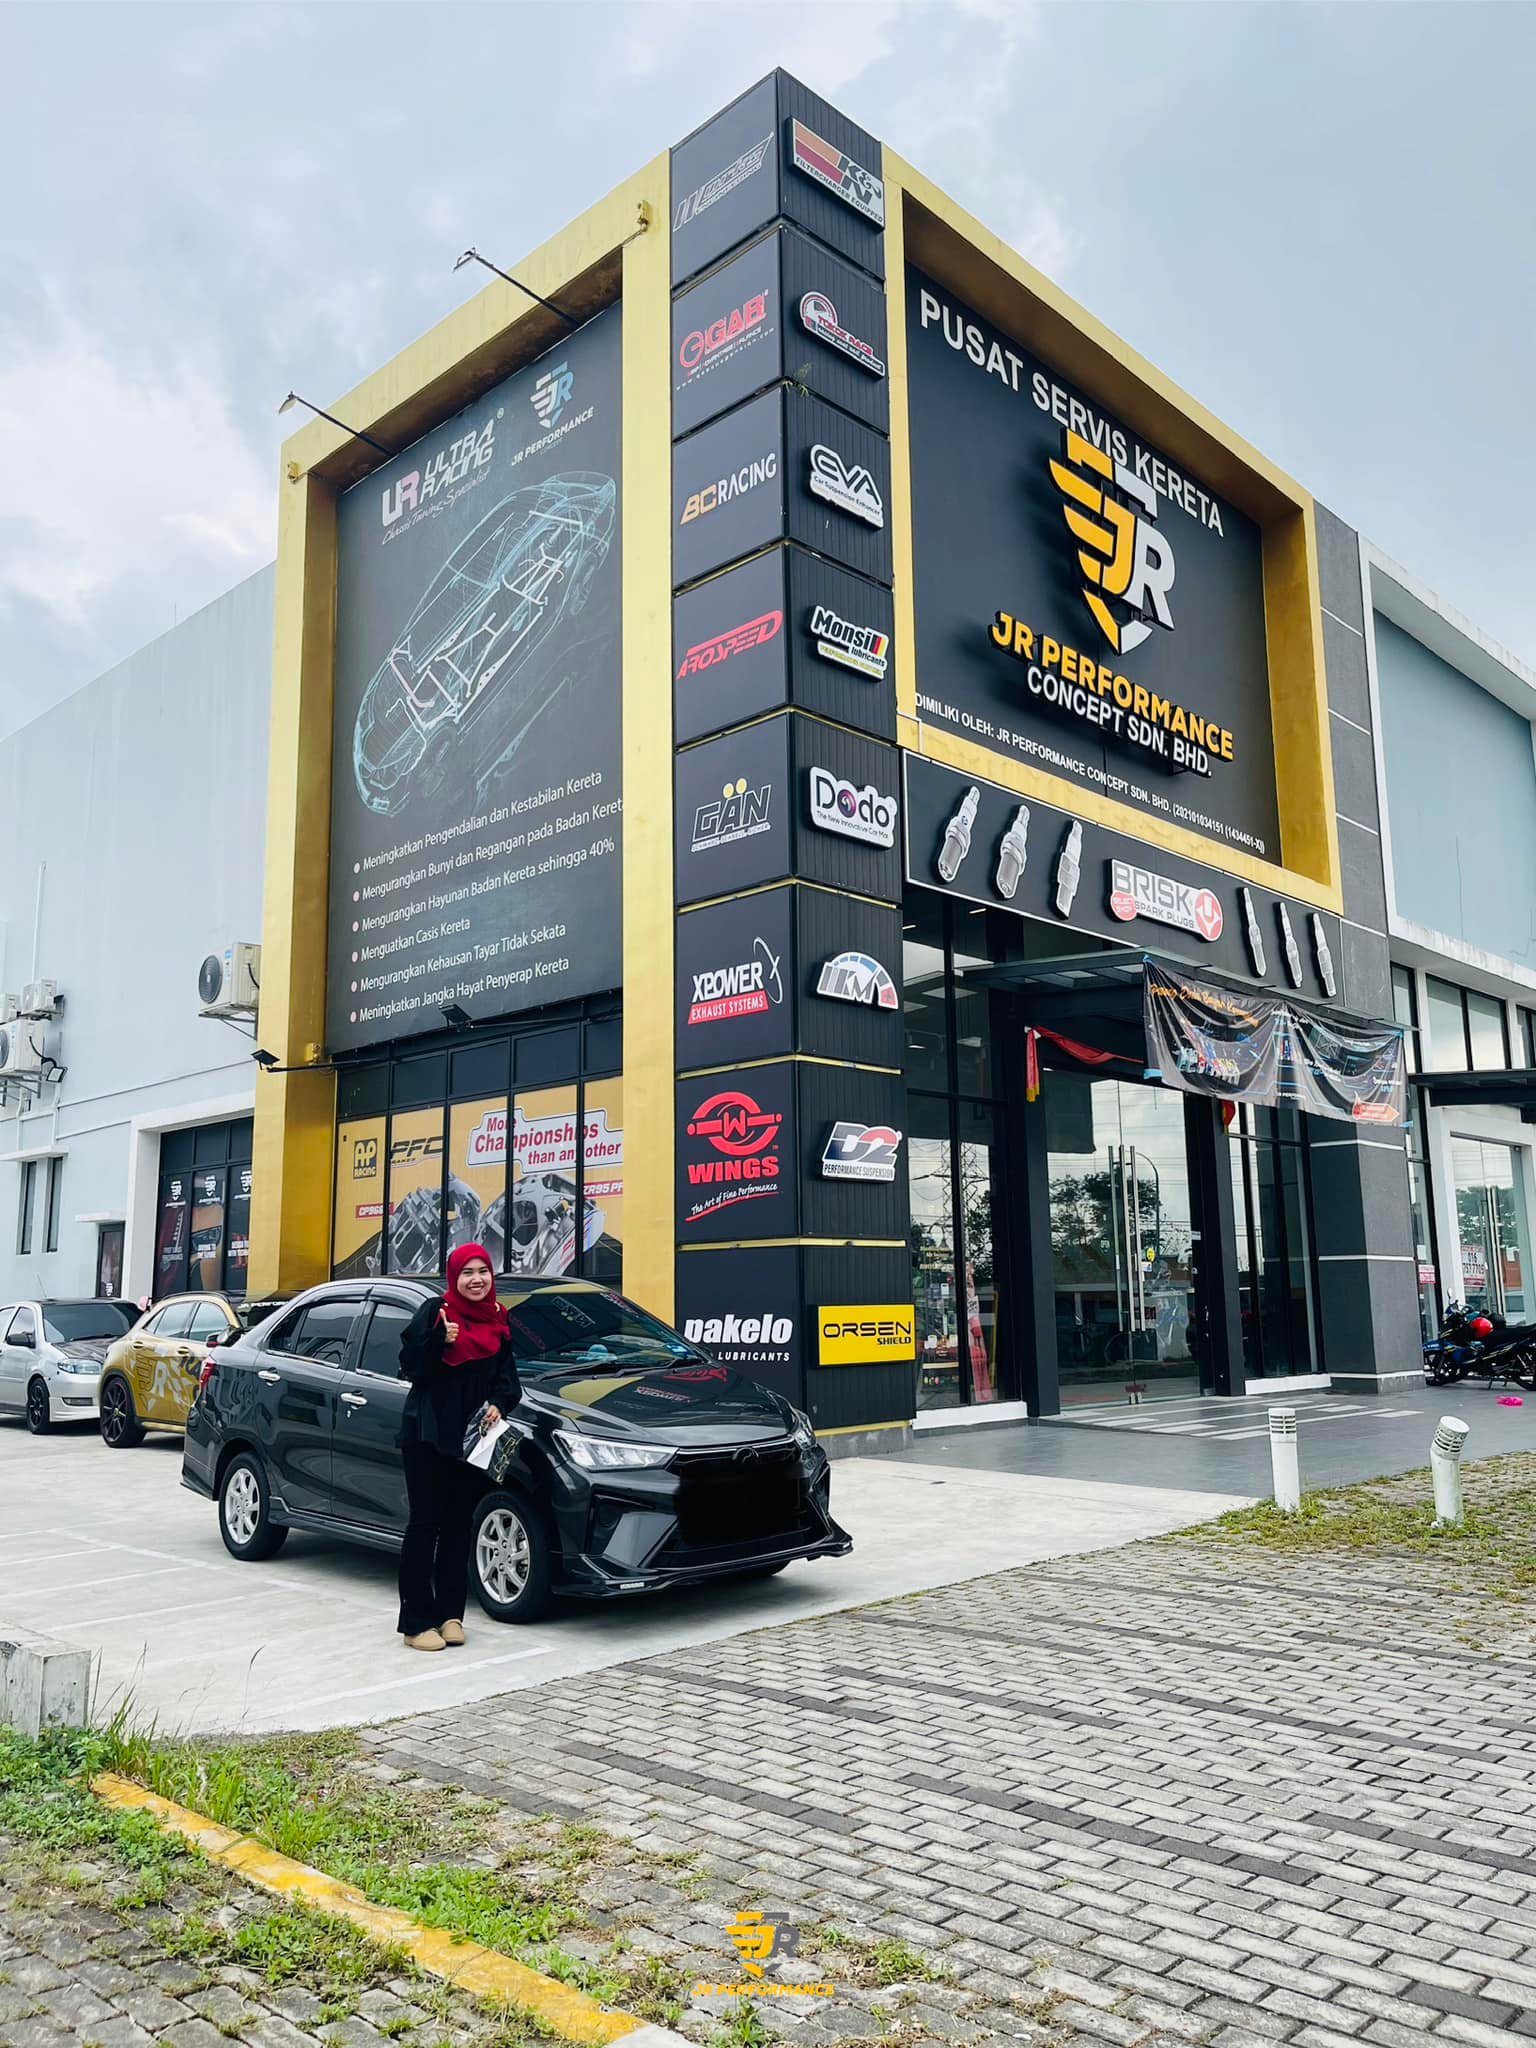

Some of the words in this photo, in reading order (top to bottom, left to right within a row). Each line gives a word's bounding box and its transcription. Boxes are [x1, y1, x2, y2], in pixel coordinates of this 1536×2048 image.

[851, 196, 883, 222] EQUIPPED
[704, 293, 766, 355] GAB
[511, 451, 524, 466] JR
[525, 406, 594, 458] PERFORMANCE
[920, 288, 1023, 391] PUSAT
[1032, 372, 1128, 467] SERVIS
[1135, 445, 1224, 537] KERETA
[420, 437, 495, 504] RACING
[425, 419, 494, 480] ULTRA
[851, 647, 885, 667] lubricants
[992, 612, 1034, 660] JR
[1041, 635, 1234, 760] PERFORMANCE
[1028, 666, 1124, 733] CONCEPT
[1127, 716, 1169, 758] SDN.
[1173, 739, 1212, 777] BHD.
[914, 693, 959, 723] DIMILIKI
[961, 712, 995, 737] OLEH:
[996, 727, 1010, 744] JR
[1012, 733, 1086, 776] PERFORMANCE
[1087, 766, 1128, 794] CONCEPT
[1131, 786, 1150, 803] SDN.
[1152, 794, 1171, 812] BHD.
[363, 838, 423, 871] Meningkatkan
[424, 813, 488, 847] Pengendalian
[489, 807, 509, 824] dan
[510, 786, 565, 816] Kestabilan
[566, 770, 602, 795] Kereta
[816, 775, 889, 827] Dodo
[362, 866, 427, 901] Mengurangkan
[428, 853, 454, 878] Bunyi
[455, 850, 474, 867] dan
[475, 832, 526, 861] Regangan
[527, 822, 553, 848] pada
[555, 808, 590, 833] Badan
[592, 798, 623, 821] Keret
[361, 899, 427, 932] Mengurangkan
[428, 884, 470, 910] Hayunan
[471, 876, 502, 898] Badan
[503, 863, 536, 886] Kereta
[538, 848, 588, 875] sehingga
[589, 837, 615, 858] 40%
[1114, 863, 1192, 916] BRISK
[361, 934, 415, 962] Menguatkan
[416, 928, 439, 944] Casis
[440, 917, 470, 937] Kereta
[1135, 901, 1164, 918] SPARK
[1167, 911, 1194, 928] PLUGS
[360, 961, 425, 992] Mengurangkan
[427, 946, 472, 971] Kehausan
[473, 940, 500, 964] Tayar
[501, 932, 528, 953] Tidak
[530, 922, 566, 943] Sekata
[359, 994, 421, 1022] Meningkatkan
[421, 985, 455, 1008] Jangka
[456, 976, 484, 998] Hayat
[485, 965, 533, 992] Penyerap
[535, 956, 569, 977] Kereta
[692, 1002, 727, 1020] EXHAUST
[729, 995, 764, 1014] SYSTEMS
[354, 1166, 376, 1177] RACING
[528, 1150, 555, 1165] than
[559, 1147, 577, 1163] an
[585, 1142, 621, 1158] other
[687, 1156, 779, 1184] WINGS
[824, 1163, 862, 1176] PERFORMANCE
[863, 1166, 894, 1178] SUSPENSION
[691, 1203, 703, 1215] The
[704, 1197, 716, 1208] Art
[723, 1191, 737, 1200] Fine
[738, 1183, 778, 1199] Performance
[823, 1321, 912, 1338] ORSEN
[877, 1336, 912, 1346] SHIELD
[718, 1351, 790, 1361] LUBRICANTS
